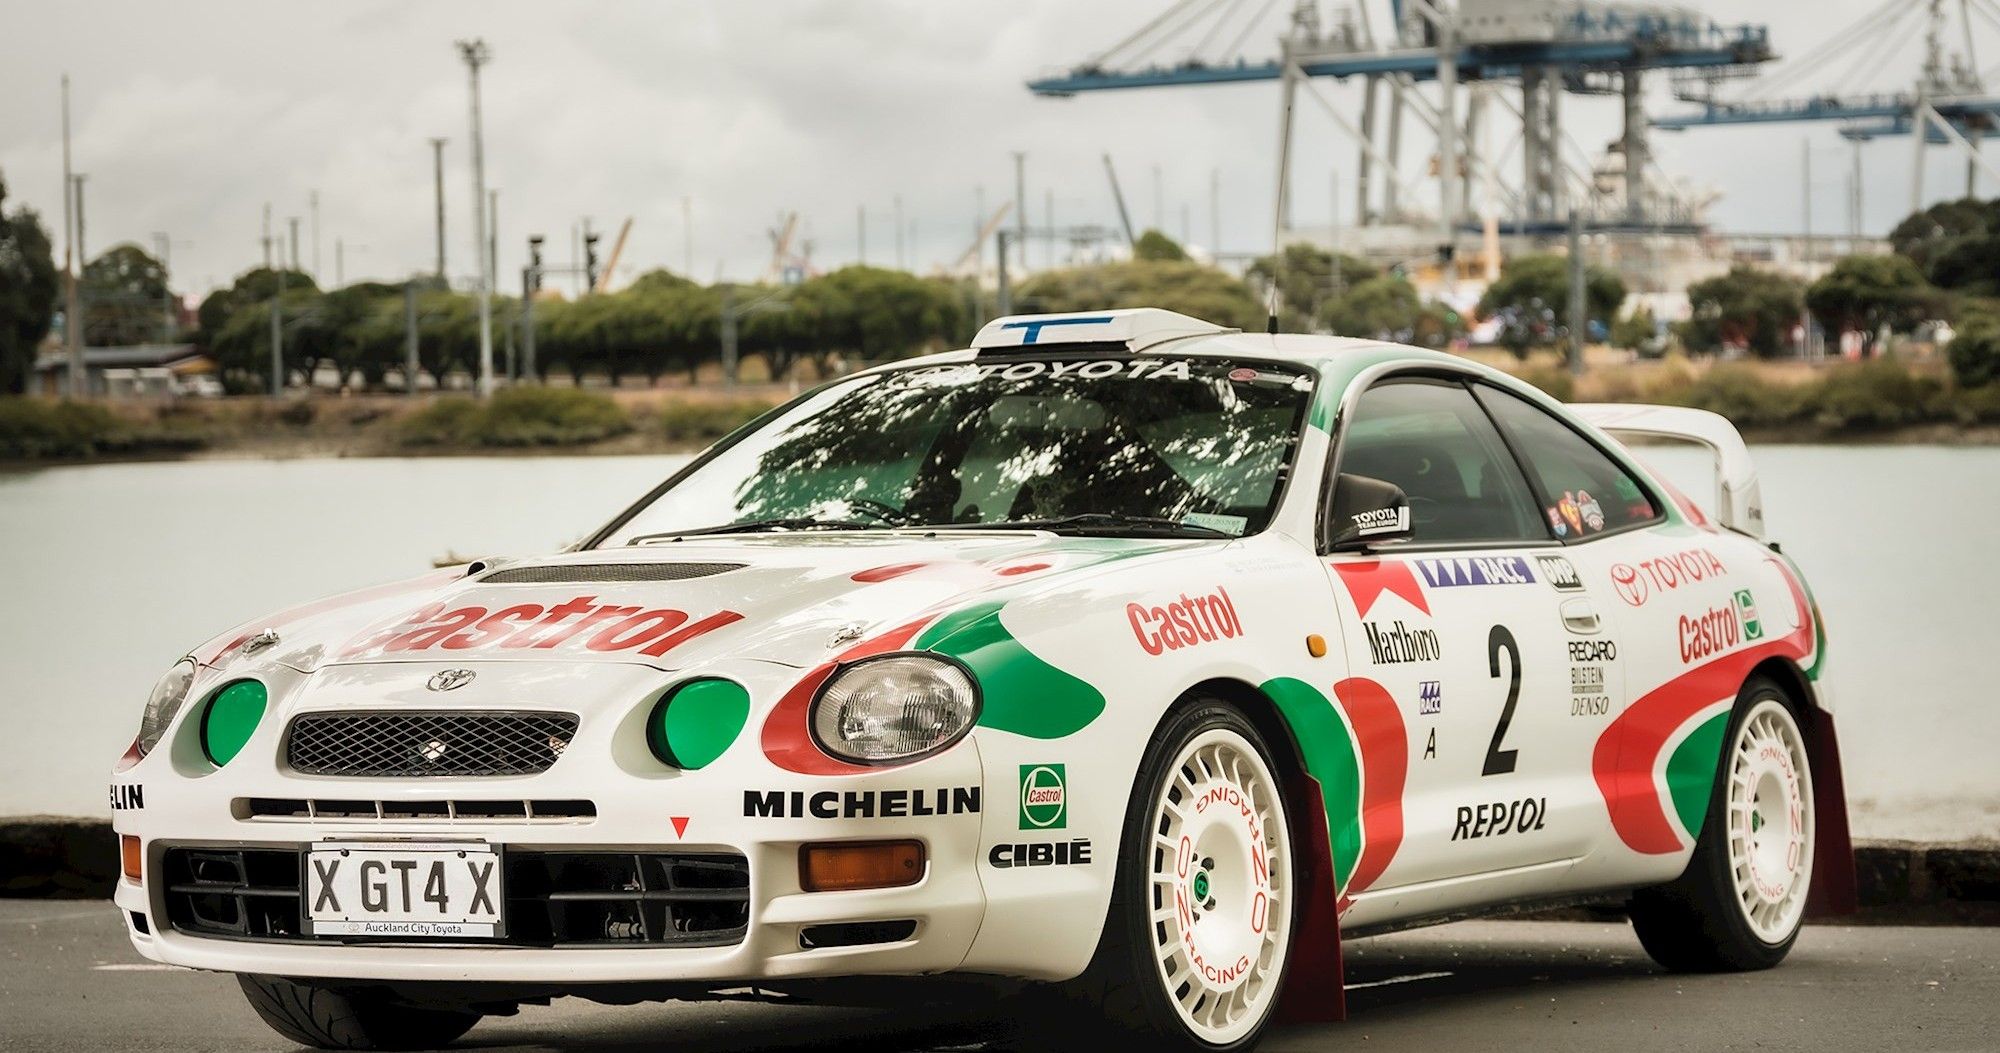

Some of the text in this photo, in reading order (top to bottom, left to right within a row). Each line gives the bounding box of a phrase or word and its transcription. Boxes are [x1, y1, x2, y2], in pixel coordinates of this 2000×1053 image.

[977, 361, 1190, 380] TOYOTA
[1351, 508, 1397, 524] TOYOTA
[1475, 557, 1526, 584] RACC
[1640, 548, 1727, 592] TOYOTA
[340, 596, 746, 657] Castrol
[1126, 584, 1243, 656] Castrol
[1679, 598, 1739, 664] Castrol
[1363, 621, 1440, 664] Marlboro
[1568, 640, 1616, 661] RECARO
[1571, 666, 1604, 684] BILSTEIN
[1420, 697, 1440, 712] RACC
[1482, 624, 1521, 777] 2
[1571, 696, 1609, 716] DENSO
[1424, 727, 1436, 760] A
[743, 786, 980, 818] MICHELIN
[1029, 788, 1061, 803] Castrol
[1197, 787, 1259, 840] RACING
[1451, 798, 1546, 841] REPSOL
[313, 859, 496, 914] X GT4 X
[365, 922, 462, 935] Auckland City Toyota
[1185, 934, 1249, 984] RACING
